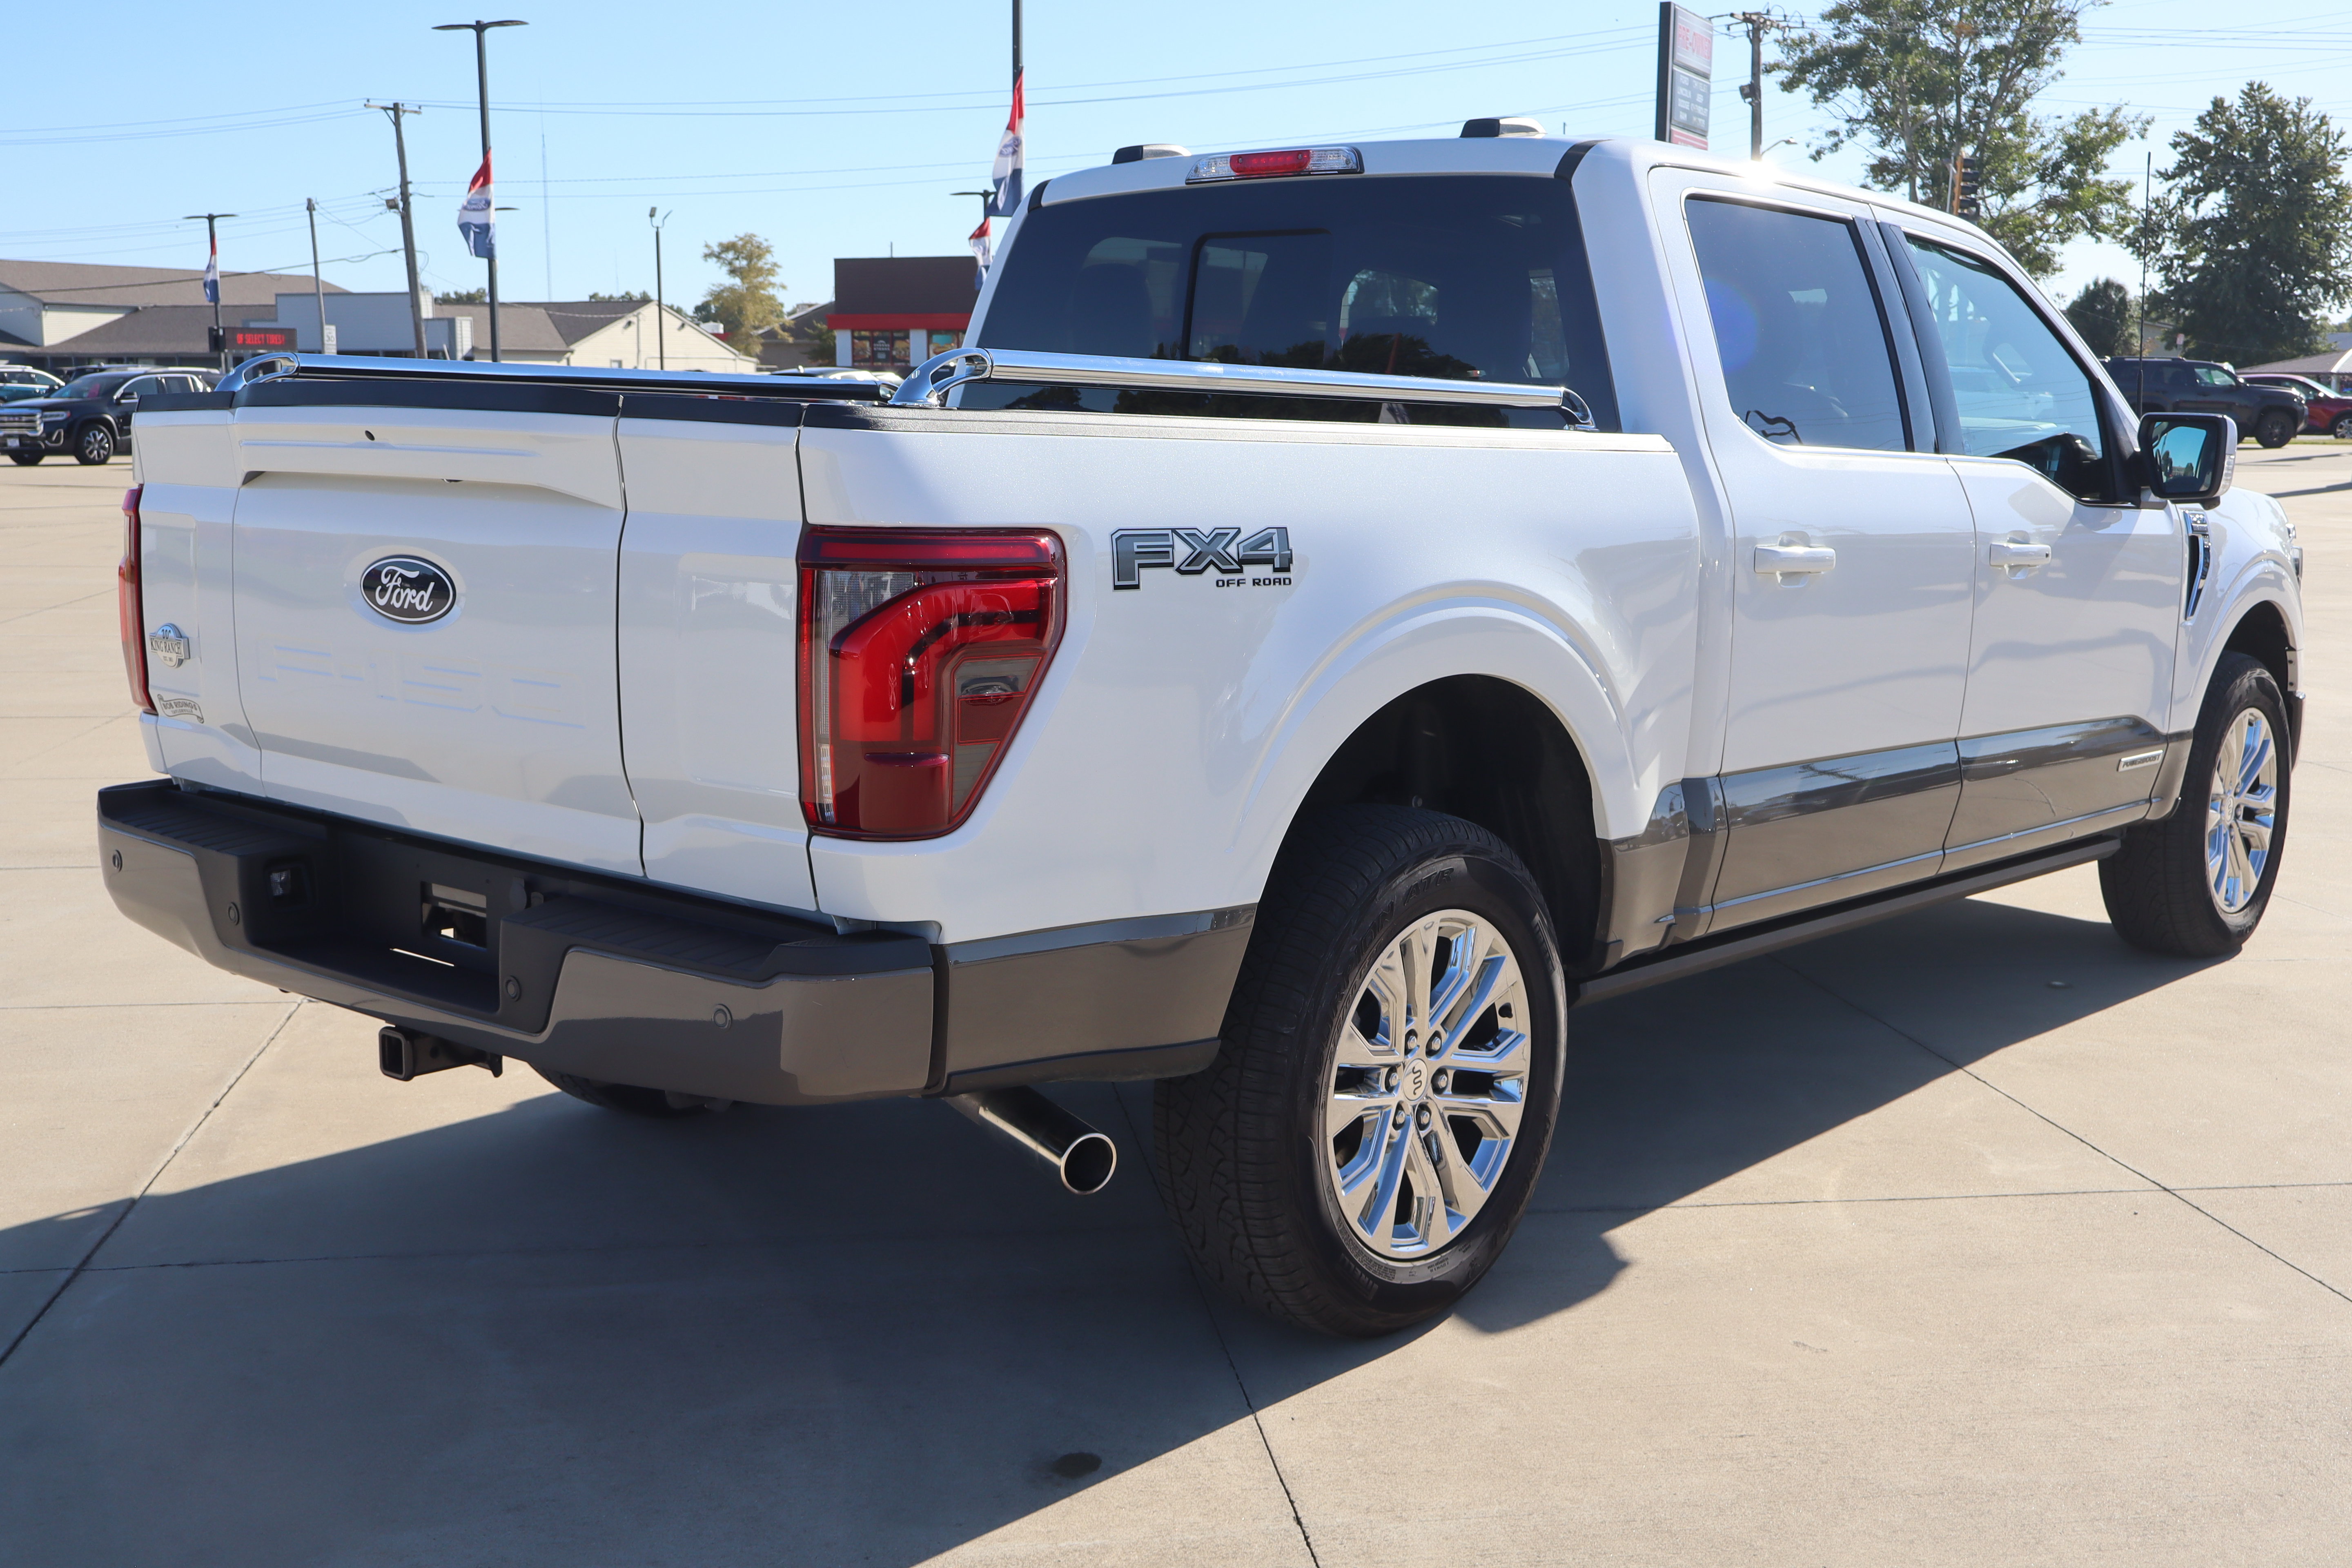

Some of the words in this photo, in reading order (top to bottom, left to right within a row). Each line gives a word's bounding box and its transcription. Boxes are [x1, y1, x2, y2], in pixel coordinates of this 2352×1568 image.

[1110, 527, 1293, 590] FX4
[375, 566, 435, 611] Ford
[1216, 579, 1246, 587] OFF
[1252, 577, 1292, 587] ROAD
[150, 638, 163, 652] KING
[164, 641, 181, 655] RANCH
[174, 701, 197, 711] RIDINGS
[2123, 755, 2160, 768] POWERBOOST
[1405, 867, 1454, 905] ATR
